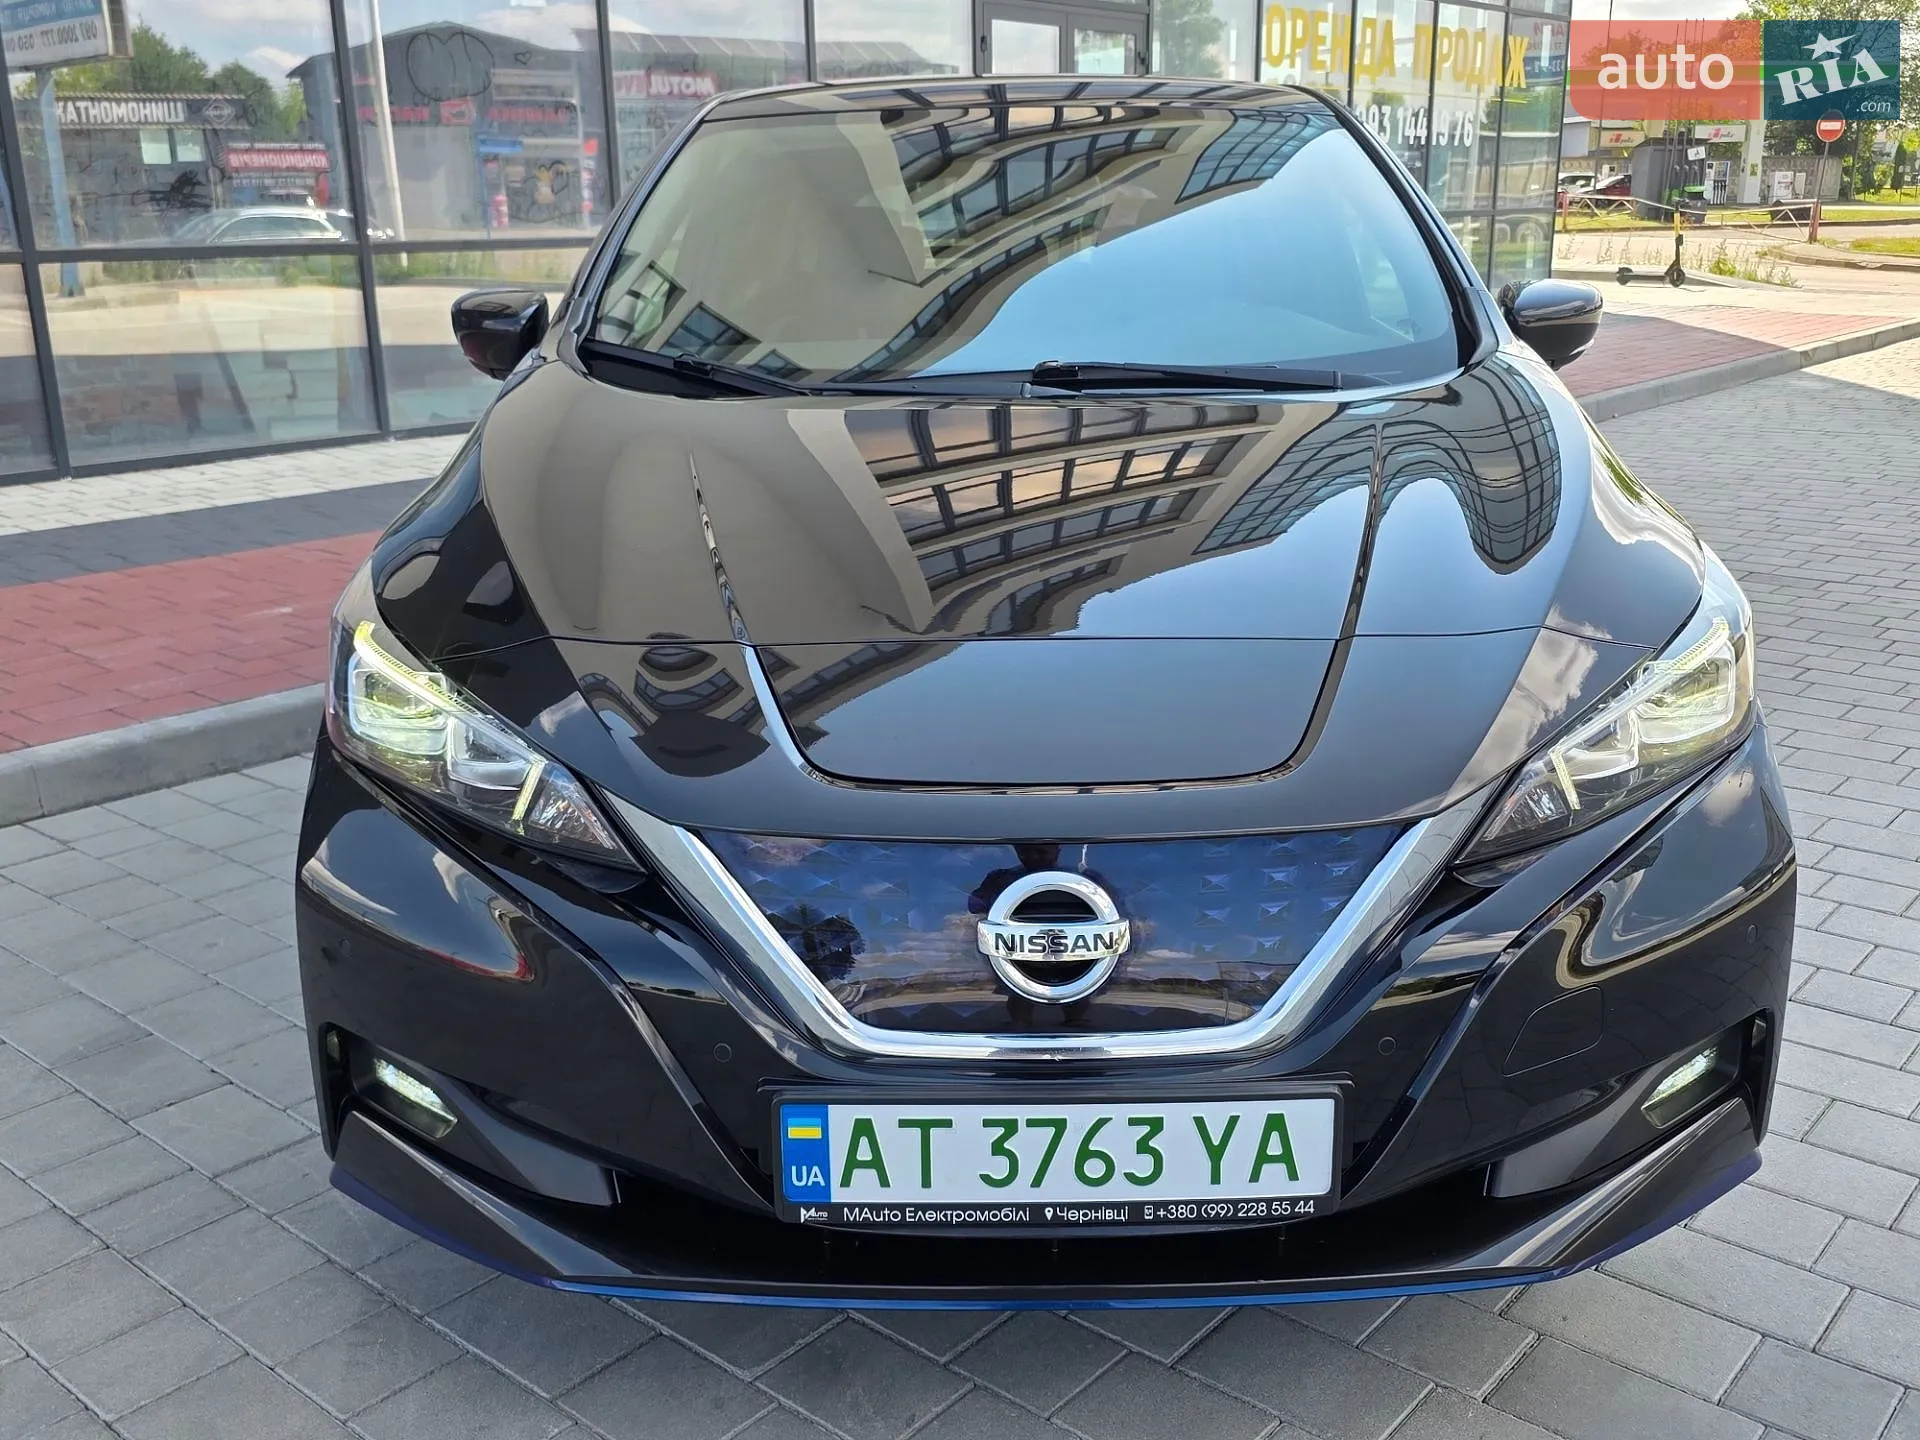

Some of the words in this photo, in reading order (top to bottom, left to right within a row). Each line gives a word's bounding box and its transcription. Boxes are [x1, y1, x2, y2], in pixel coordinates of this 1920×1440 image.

[1266, 4, 1396, 84] ОРЕНДА
[1413, 23, 1529, 91] ПРОДАЖ
[1396, 107, 1428, 145] 144
[1432, 109, 1450, 146] 19
[1454, 110, 1475, 147] 76
[994, 932, 1114, 954] NISSAN
[839, 1116, 953, 1188] AT
[978, 1116, 1165, 1188] 3763
[1192, 1112, 1301, 1186] YA
[791, 1166, 826, 1188] UA
[843, 1207, 902, 1222] MAuto
[905, 1207, 1030, 1224] Електромобілі
[1057, 1206, 1129, 1224] Чернівці
[1156, 1204, 1197, 1220] +380
[1201, 1202, 1234, 1219] (99)
[1238, 1201, 1267, 1216] 228
[1271, 1200, 1291, 1215] 55
[1295, 1199, 1315, 1214] 44
